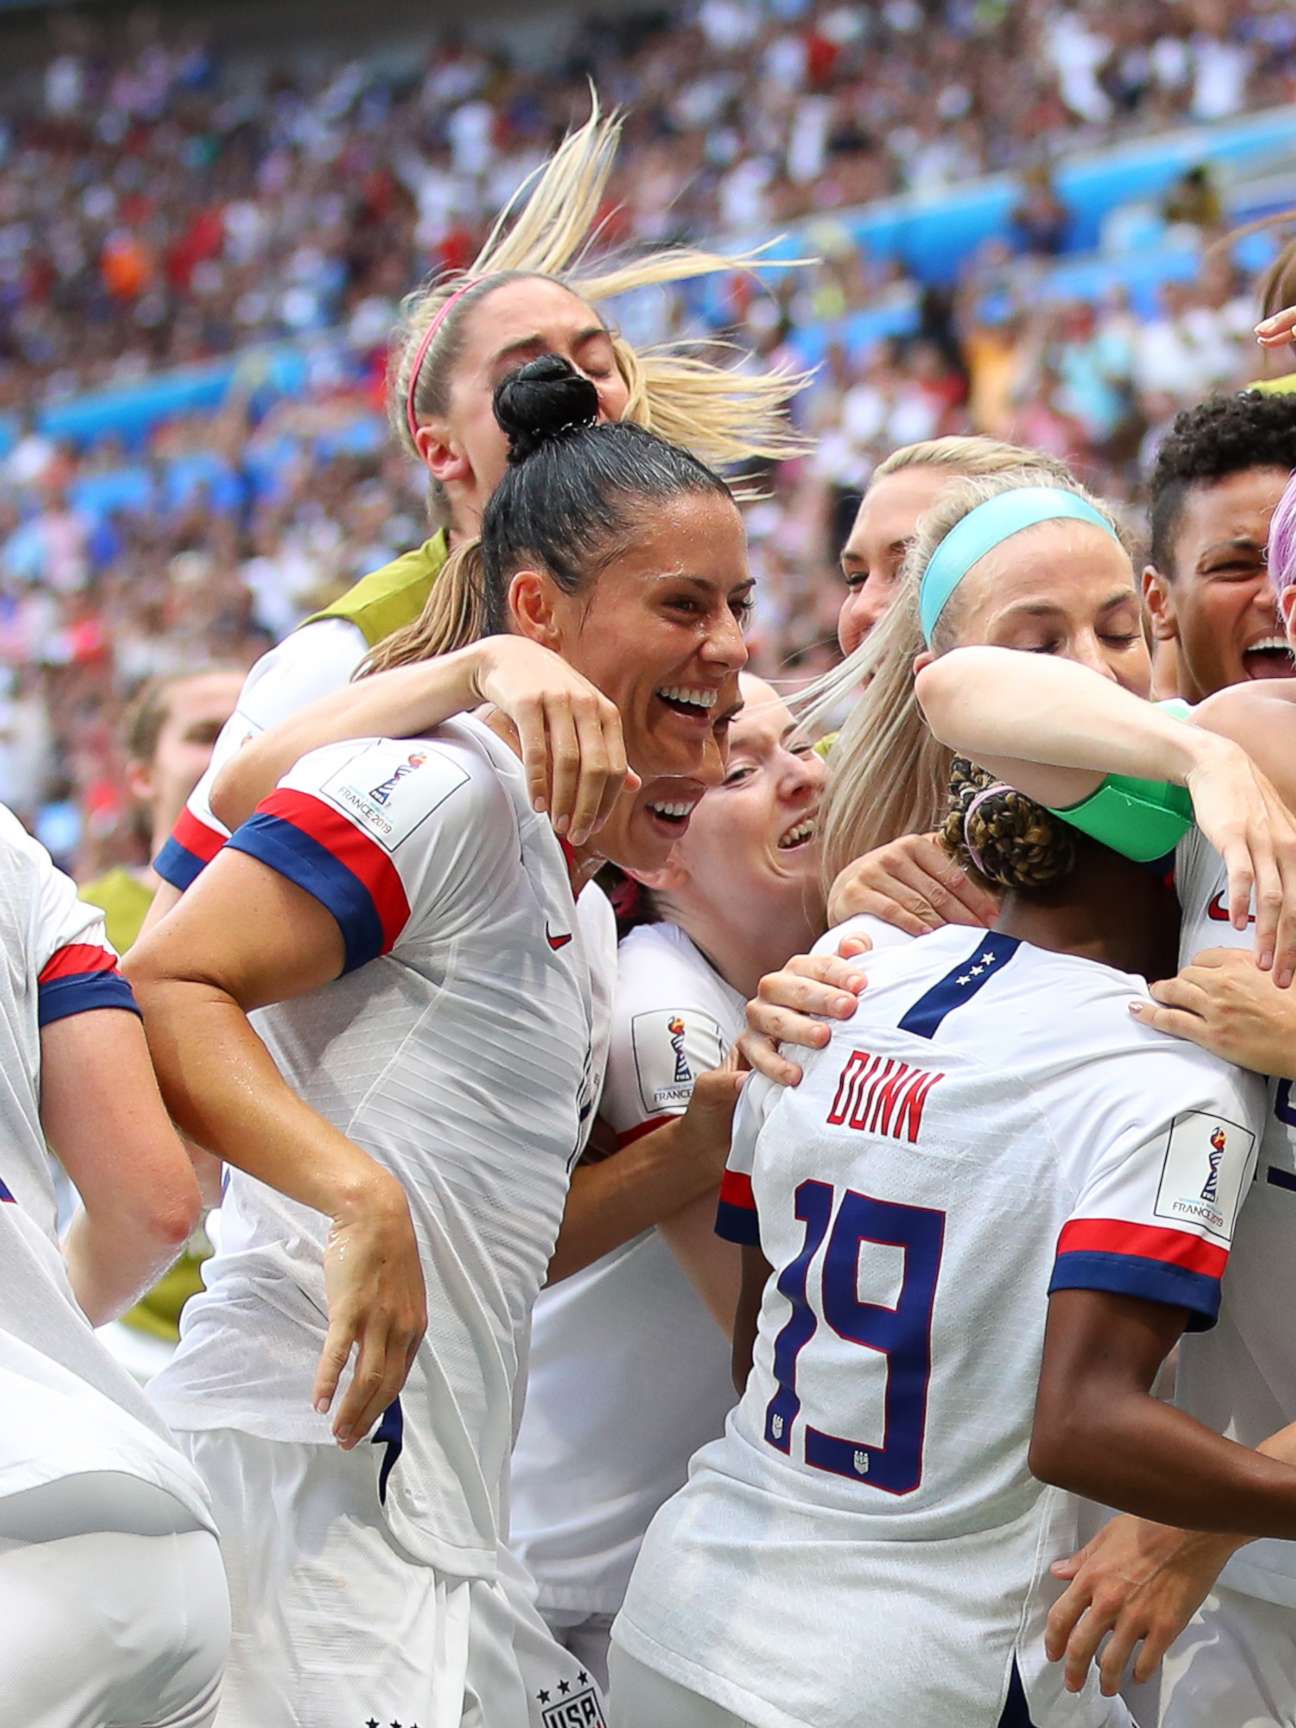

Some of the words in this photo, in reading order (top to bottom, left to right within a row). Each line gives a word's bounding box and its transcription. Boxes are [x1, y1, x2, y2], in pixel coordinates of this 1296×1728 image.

[826, 1050, 945, 1143] DUNN
[763, 1178, 947, 1496] 19
[549, 1696, 596, 1728] USA
